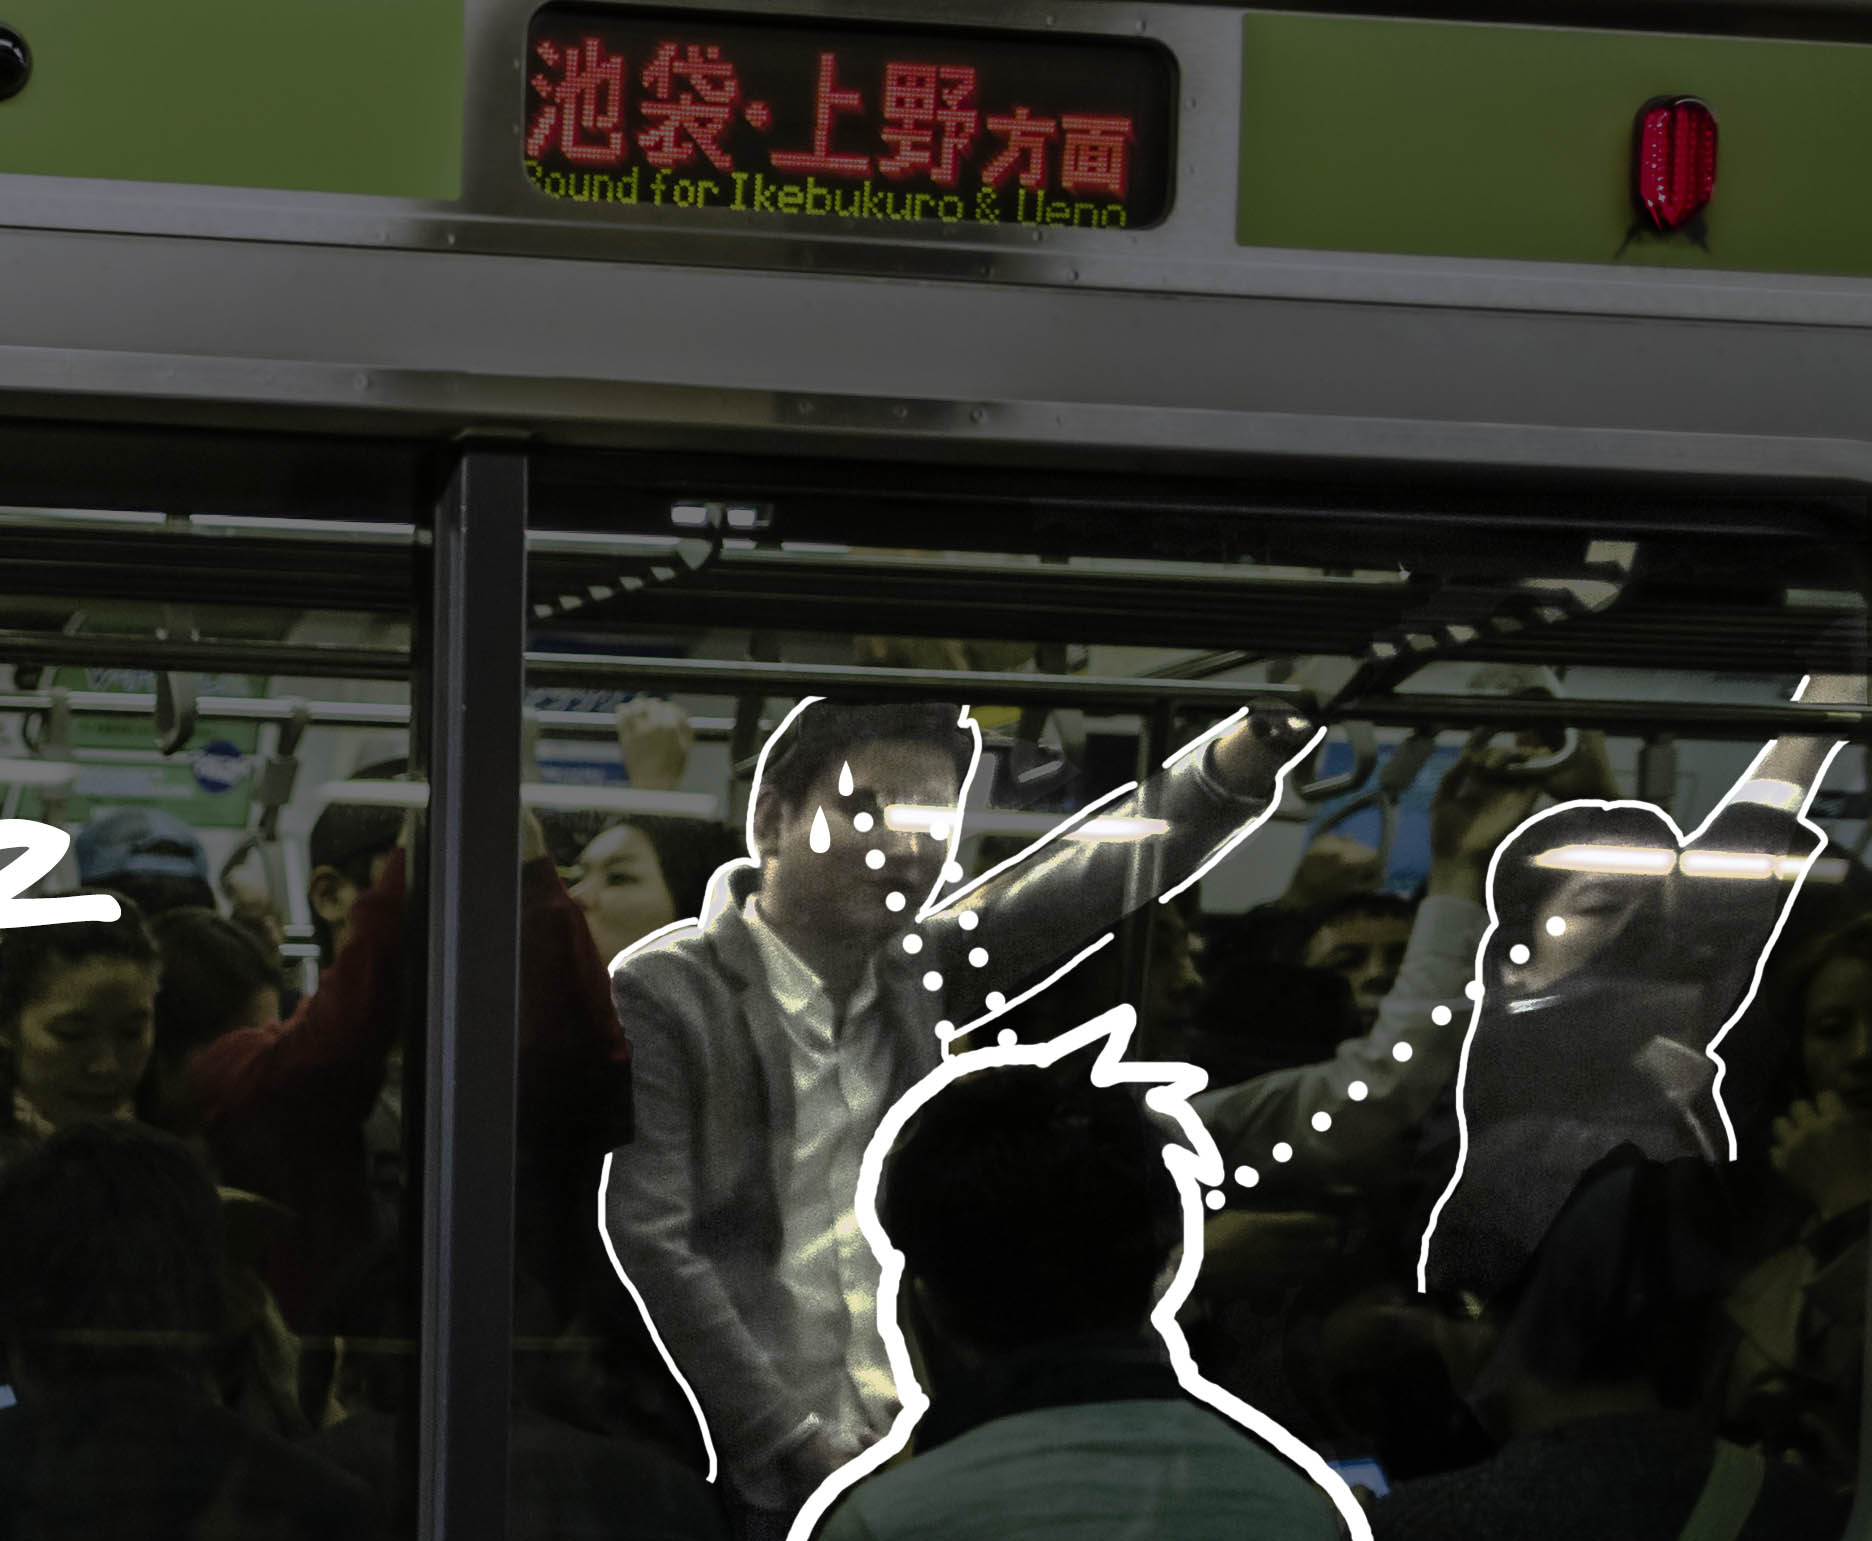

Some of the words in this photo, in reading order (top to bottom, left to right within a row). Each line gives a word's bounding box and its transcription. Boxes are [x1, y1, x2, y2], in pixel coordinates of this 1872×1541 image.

[527, 36, 1133, 192] 池袋・上野方面
[651, 168, 719, 208] for
[729, 172, 964, 222] Ikebukuro
[975, 186, 1000, 225] &
[1016, 188, 1127, 228] Ueno
